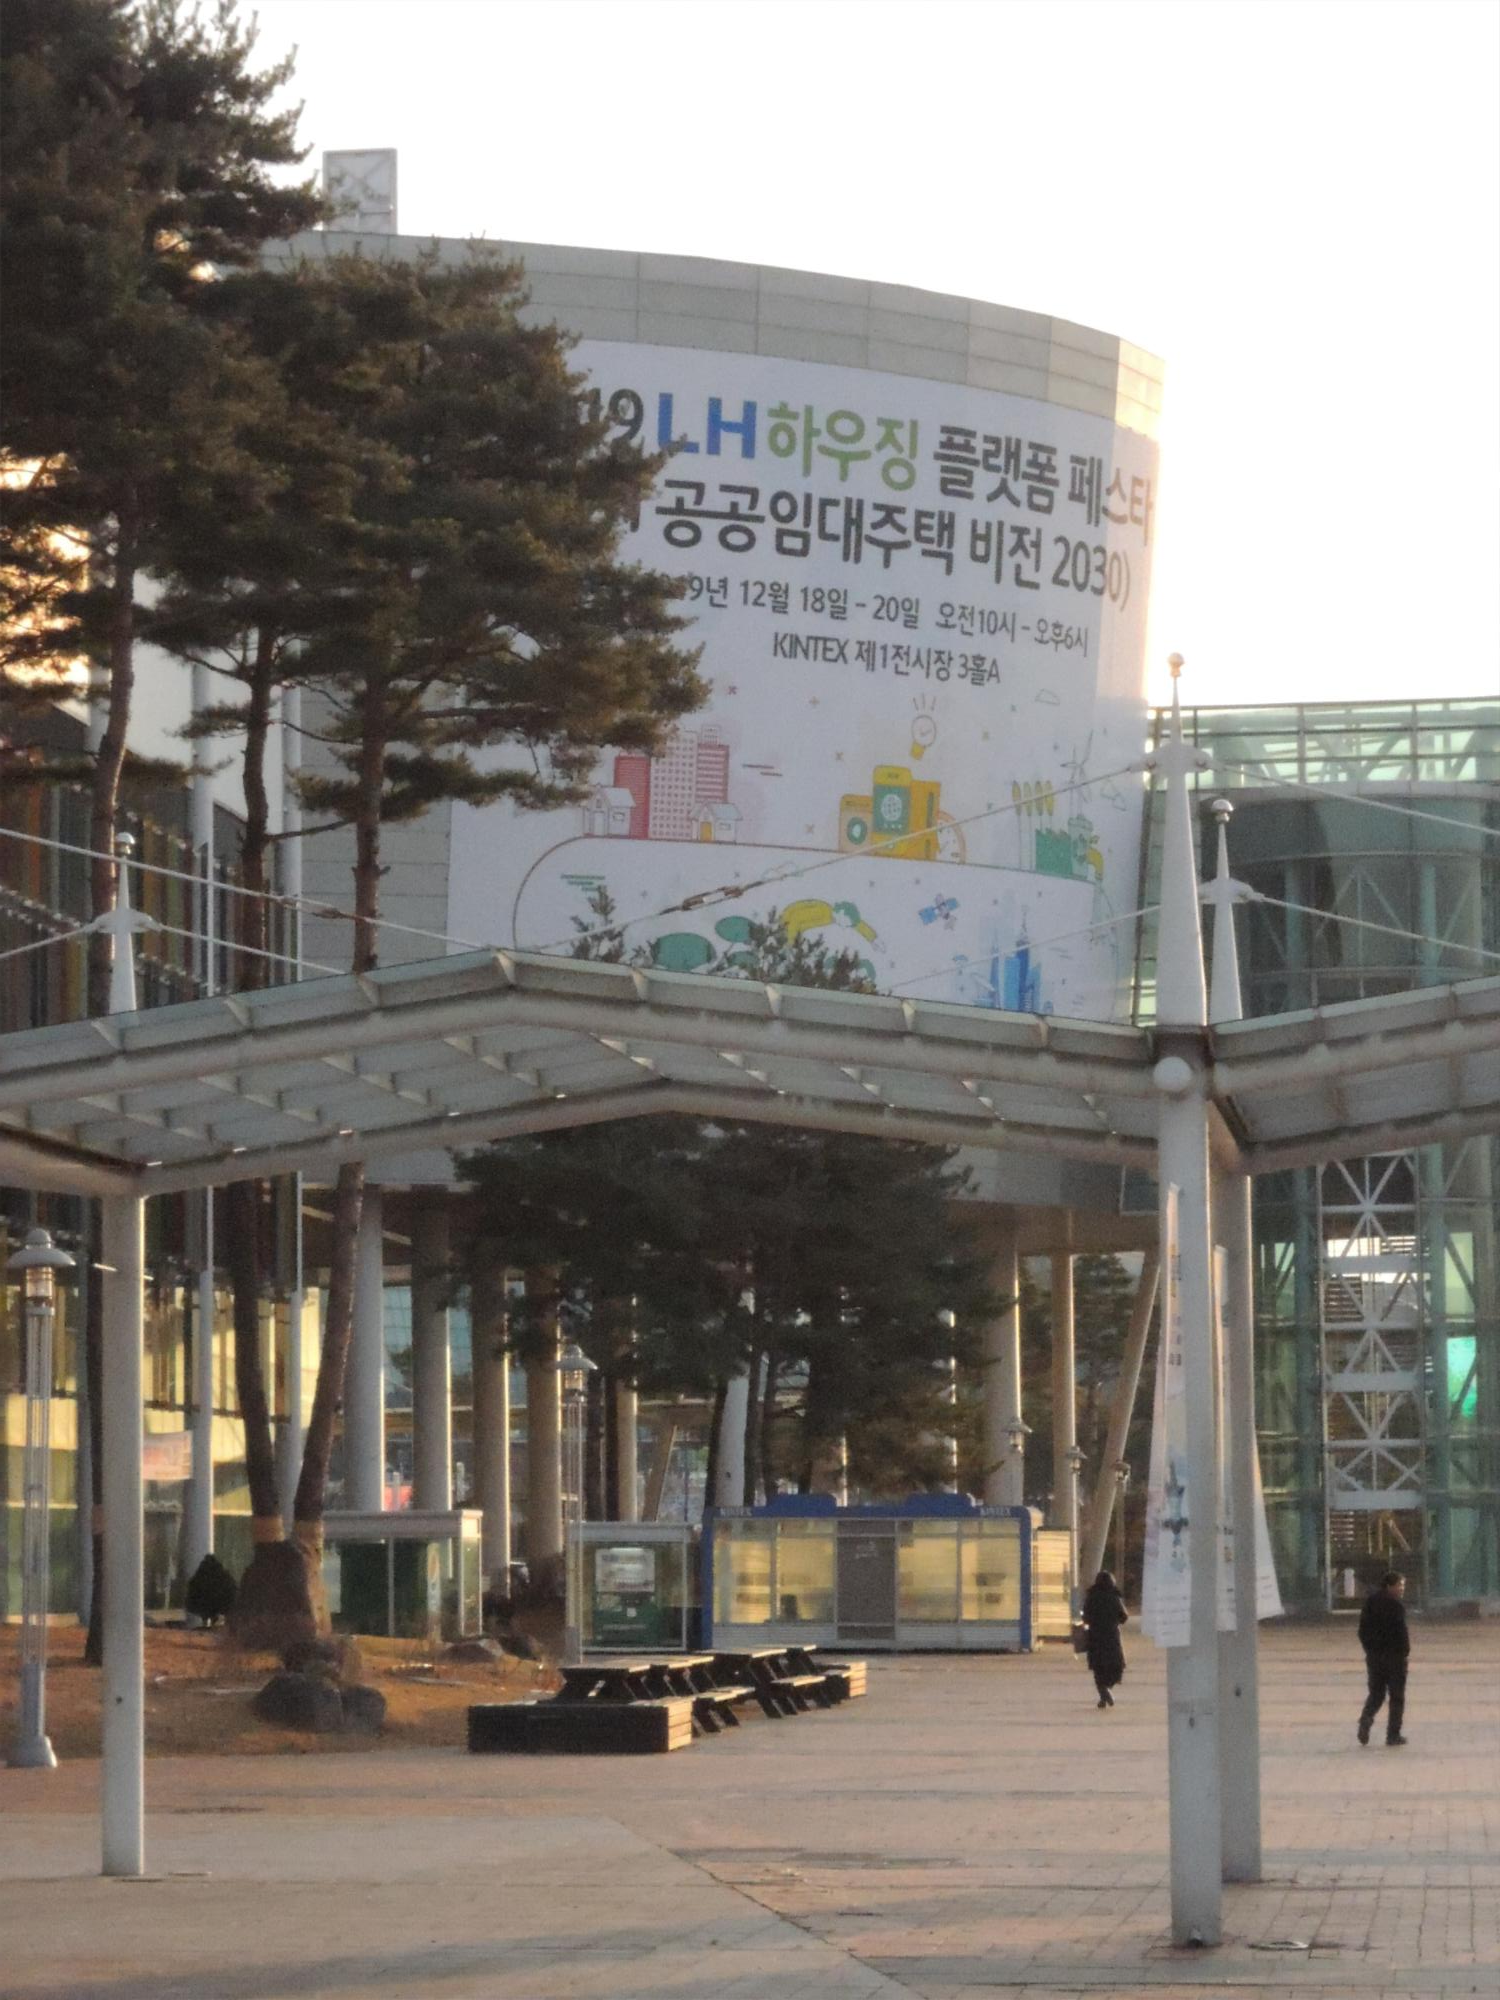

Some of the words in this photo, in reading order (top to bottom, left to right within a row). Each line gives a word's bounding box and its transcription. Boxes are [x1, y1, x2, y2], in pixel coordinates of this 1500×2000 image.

[933, 425, 1060, 515] 플랫폼
[1068, 454, 1154, 546] 페스타
[655, 479, 956, 577] 공공임대주택
[969, 518, 1043, 590] 비전
[1051, 535, 1131, 612] 2030)
[740, 580, 789, 615] 12월
[800, 586, 848, 620] 18일
[872, 595, 920, 630] 20일
[773, 631, 848, 664] KINTEX
